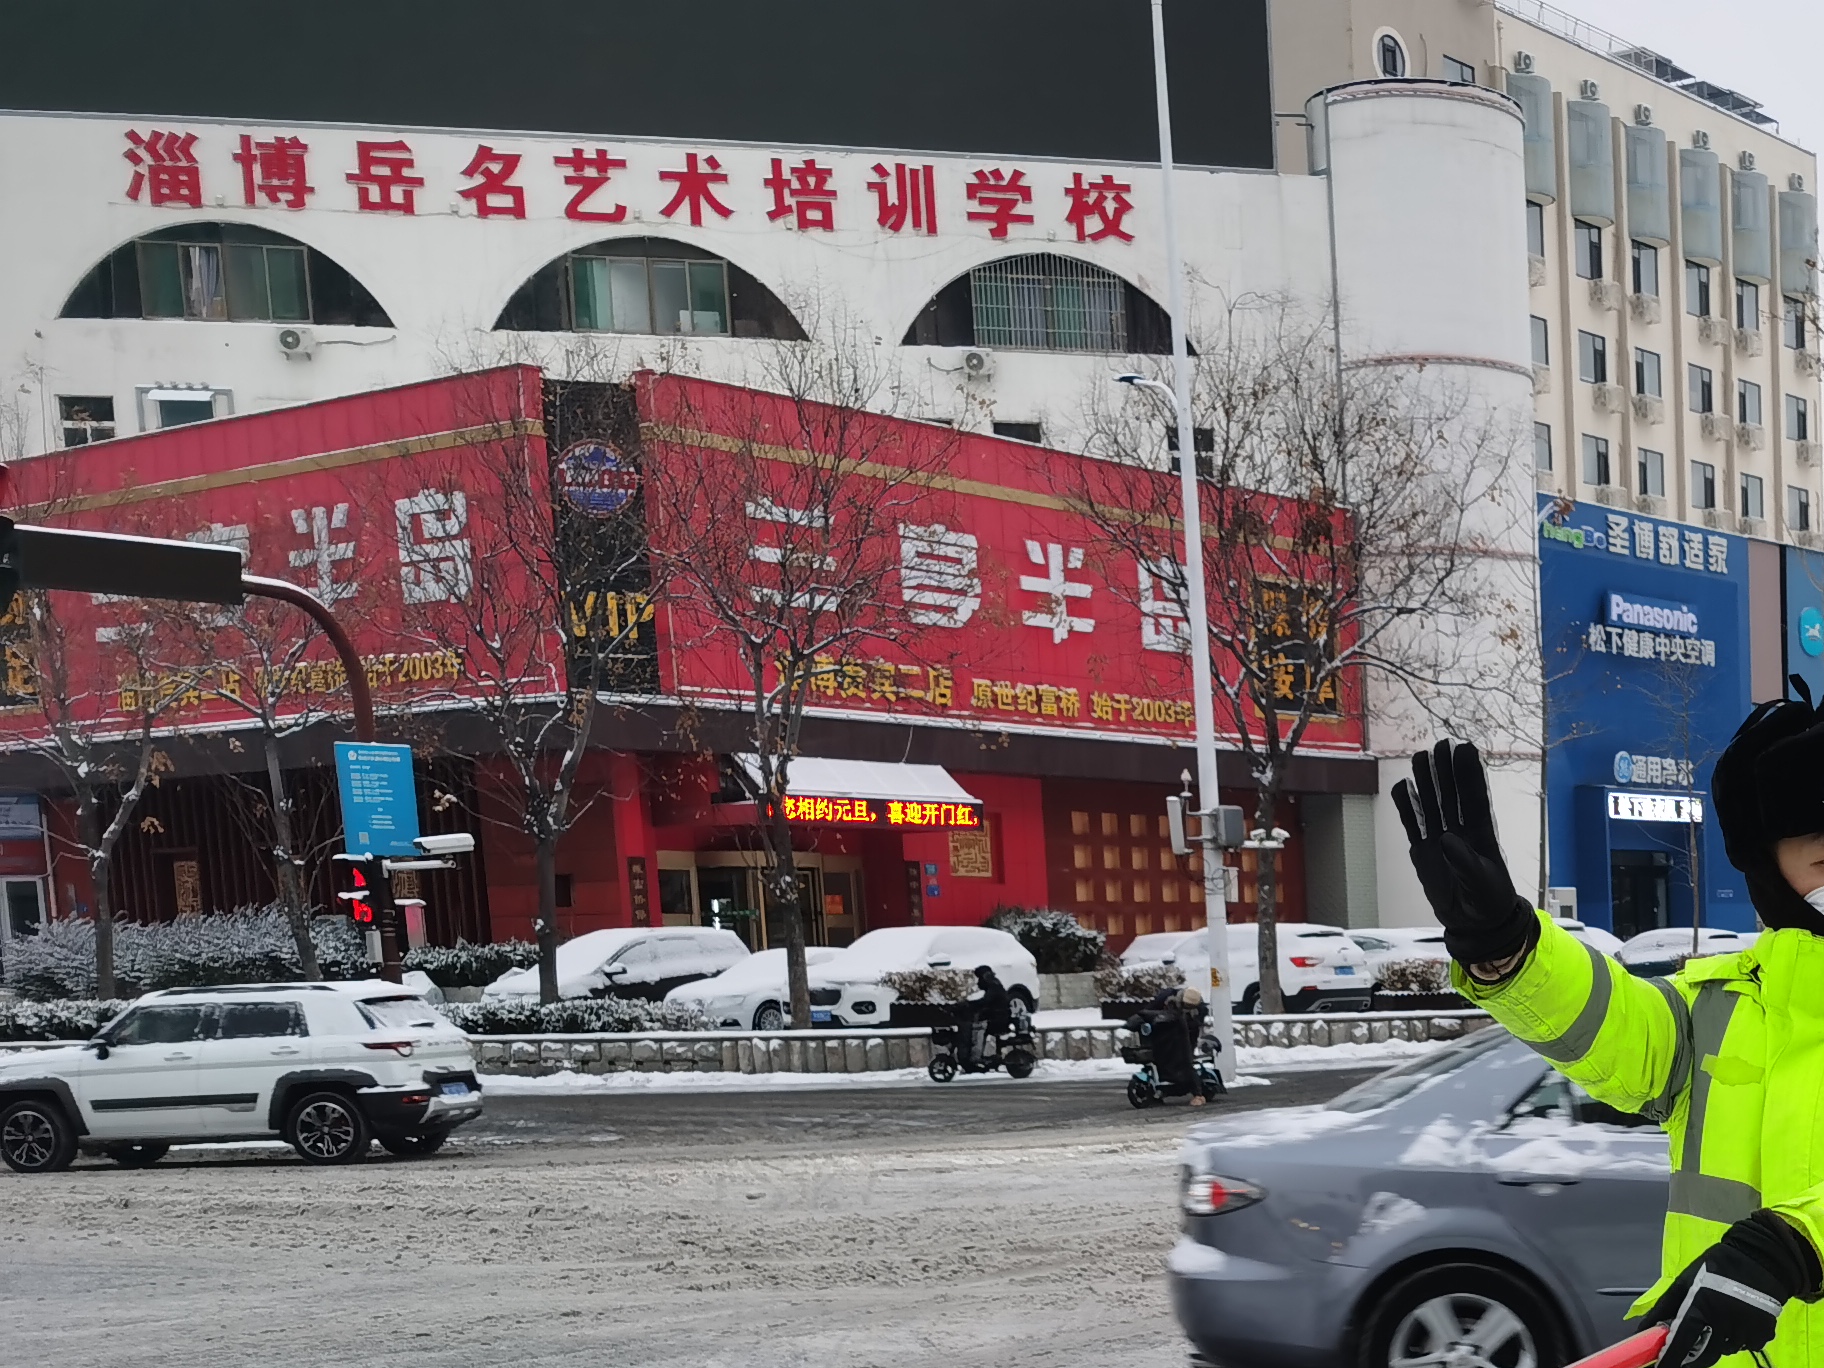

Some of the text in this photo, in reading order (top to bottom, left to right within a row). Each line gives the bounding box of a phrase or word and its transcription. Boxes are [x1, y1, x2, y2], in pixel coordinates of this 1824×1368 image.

[123, 128, 1135, 243] 淄博岳名艺术培训学校
[1606, 513, 1728, 575] 圣博舒适家
[561, 592, 655, 639] VIP
[1610, 594, 1698, 634] Panasonic
[1588, 622, 1716, 668] 松下健康中央空调
[970, 677, 1080, 718] 原世纪富桥
[1090, 691, 1195, 727] 始于2003年
